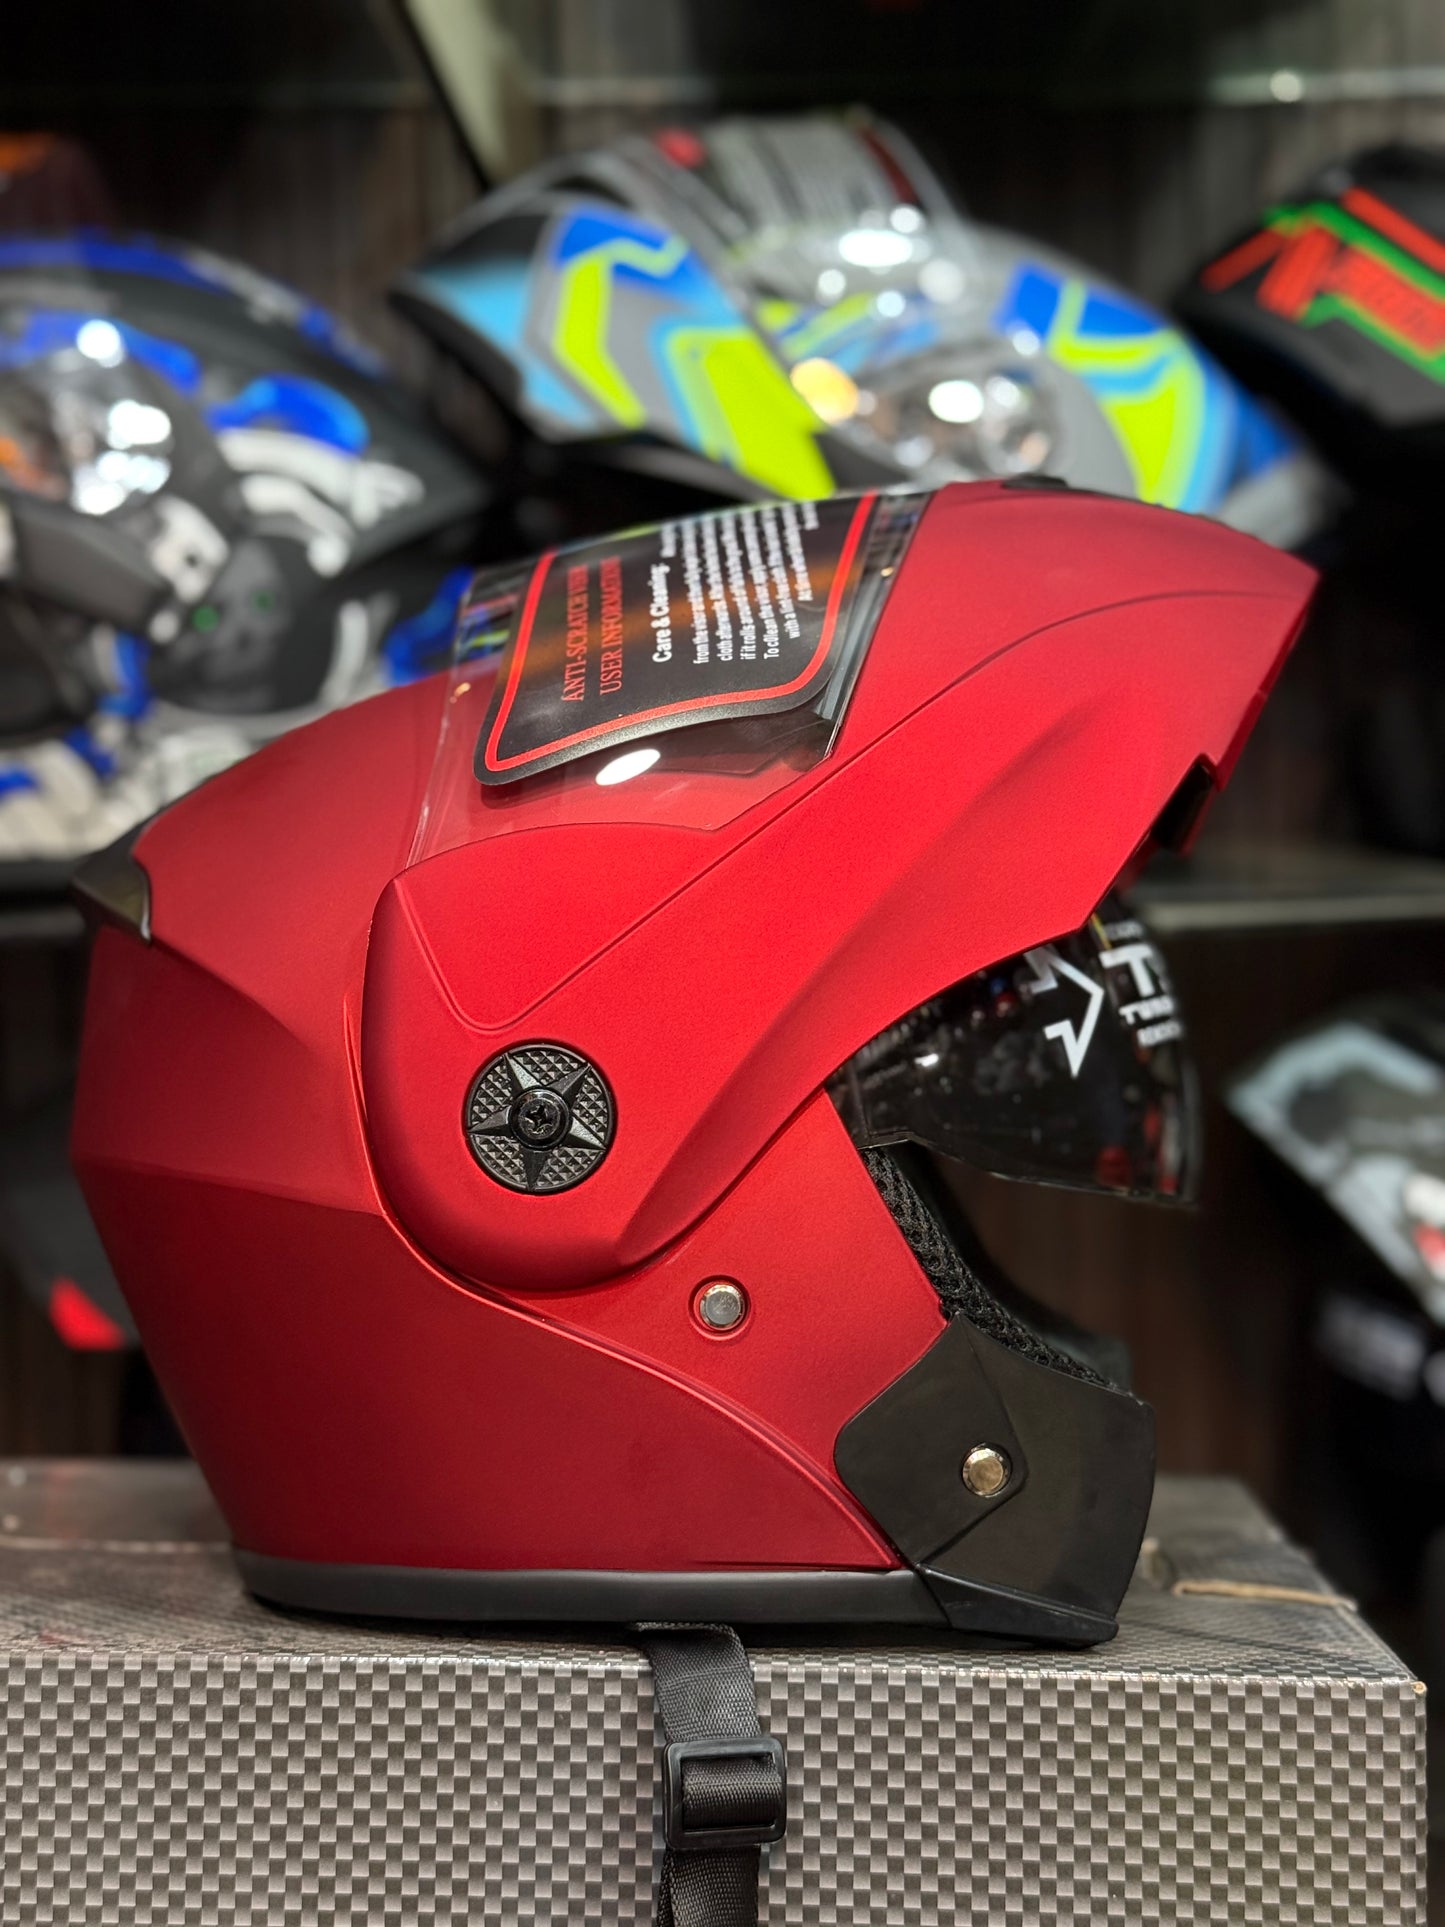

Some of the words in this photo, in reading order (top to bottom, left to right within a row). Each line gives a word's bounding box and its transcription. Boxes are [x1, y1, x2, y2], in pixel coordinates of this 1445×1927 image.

[758, 605, 775, 620] the
[649, 617, 671, 629] &
[784, 619, 801, 639] with
[691, 631, 709, 645] the
[738, 624, 755, 644] rolls
[652, 629, 672, 663] Care
[692, 644, 709, 664] from
[717, 640, 733, 661] cloth
[740, 644, 756, 652] it
[764, 648, 780, 659] To
[741, 652, 756, 660] if
[599, 648, 622, 696] USER
